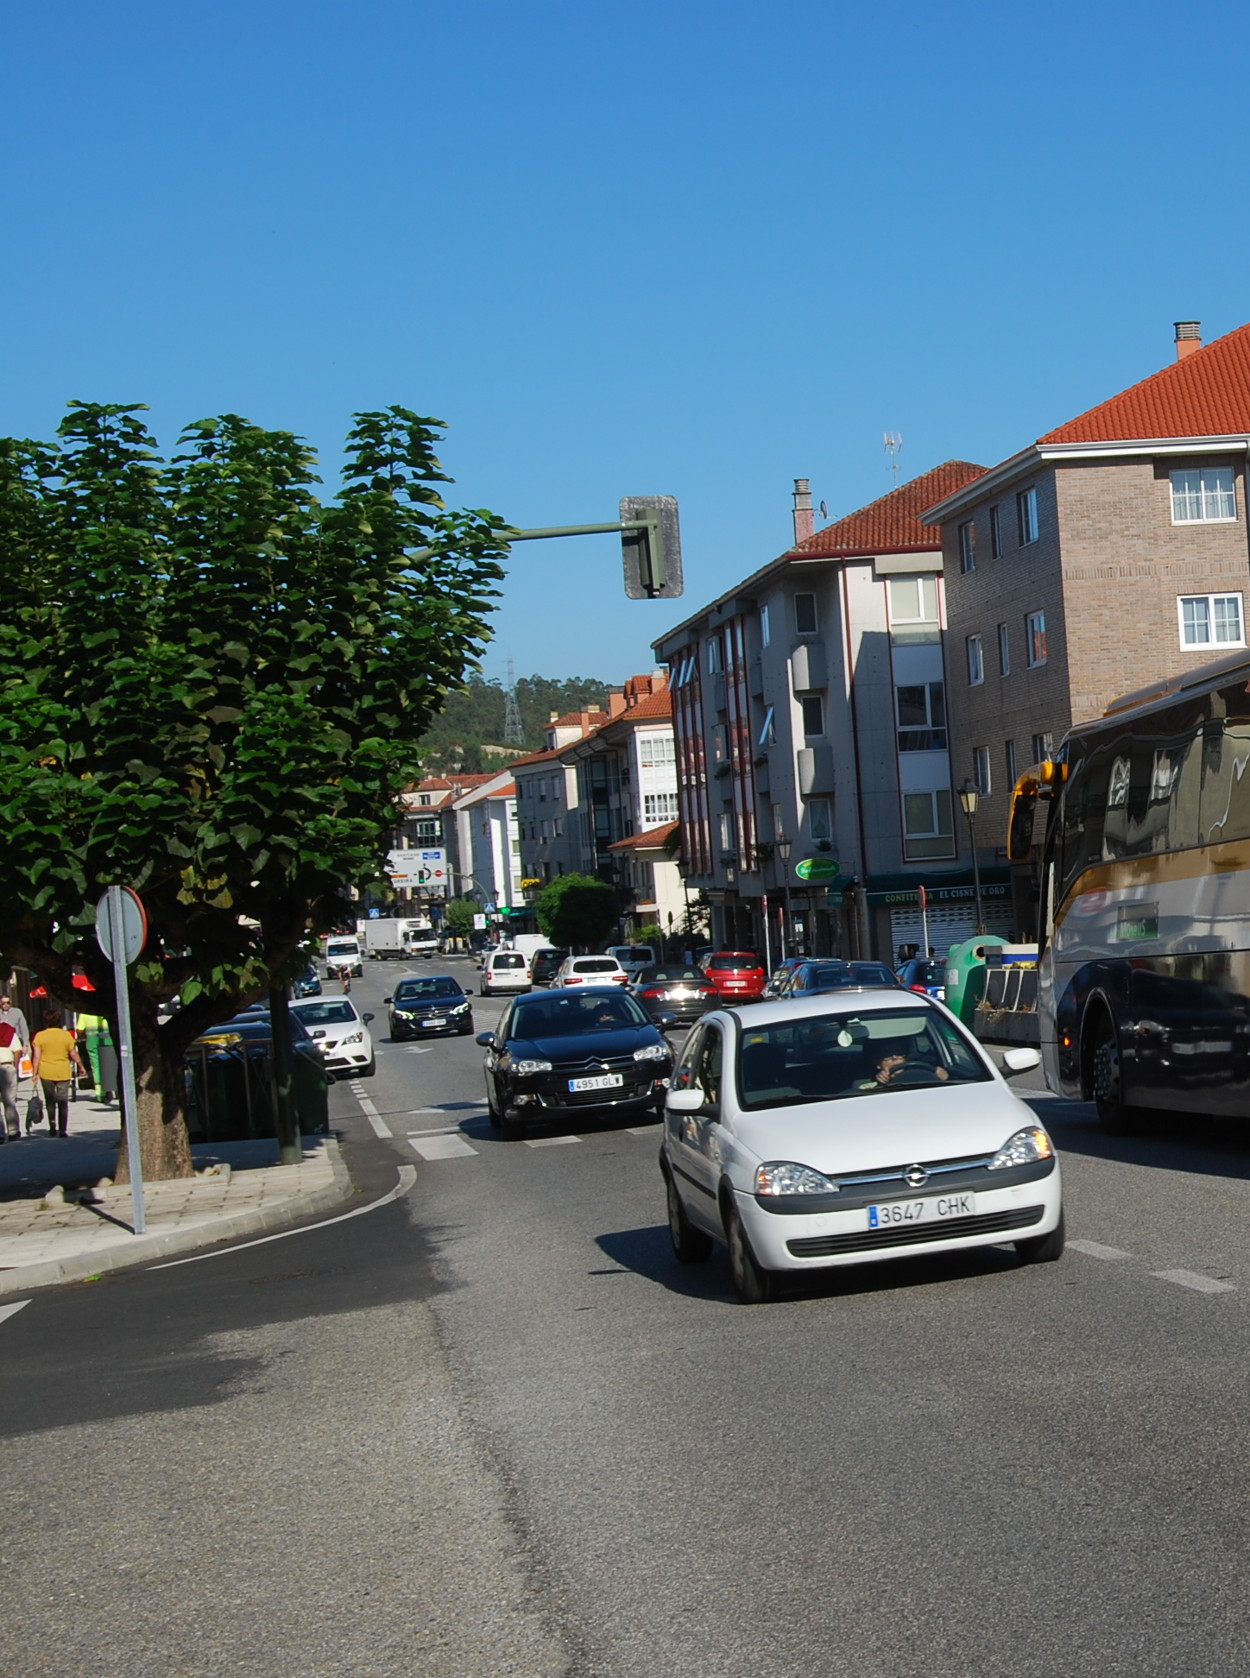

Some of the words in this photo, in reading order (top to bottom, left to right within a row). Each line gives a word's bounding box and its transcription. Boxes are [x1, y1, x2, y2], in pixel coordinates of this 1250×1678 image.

[939, 890, 949, 899] EL
[988, 886, 1005, 895] ORO
[576, 1079, 599, 1089] 4951
[880, 1202, 924, 1224] 3647
[937, 1195, 970, 1216] CHK
